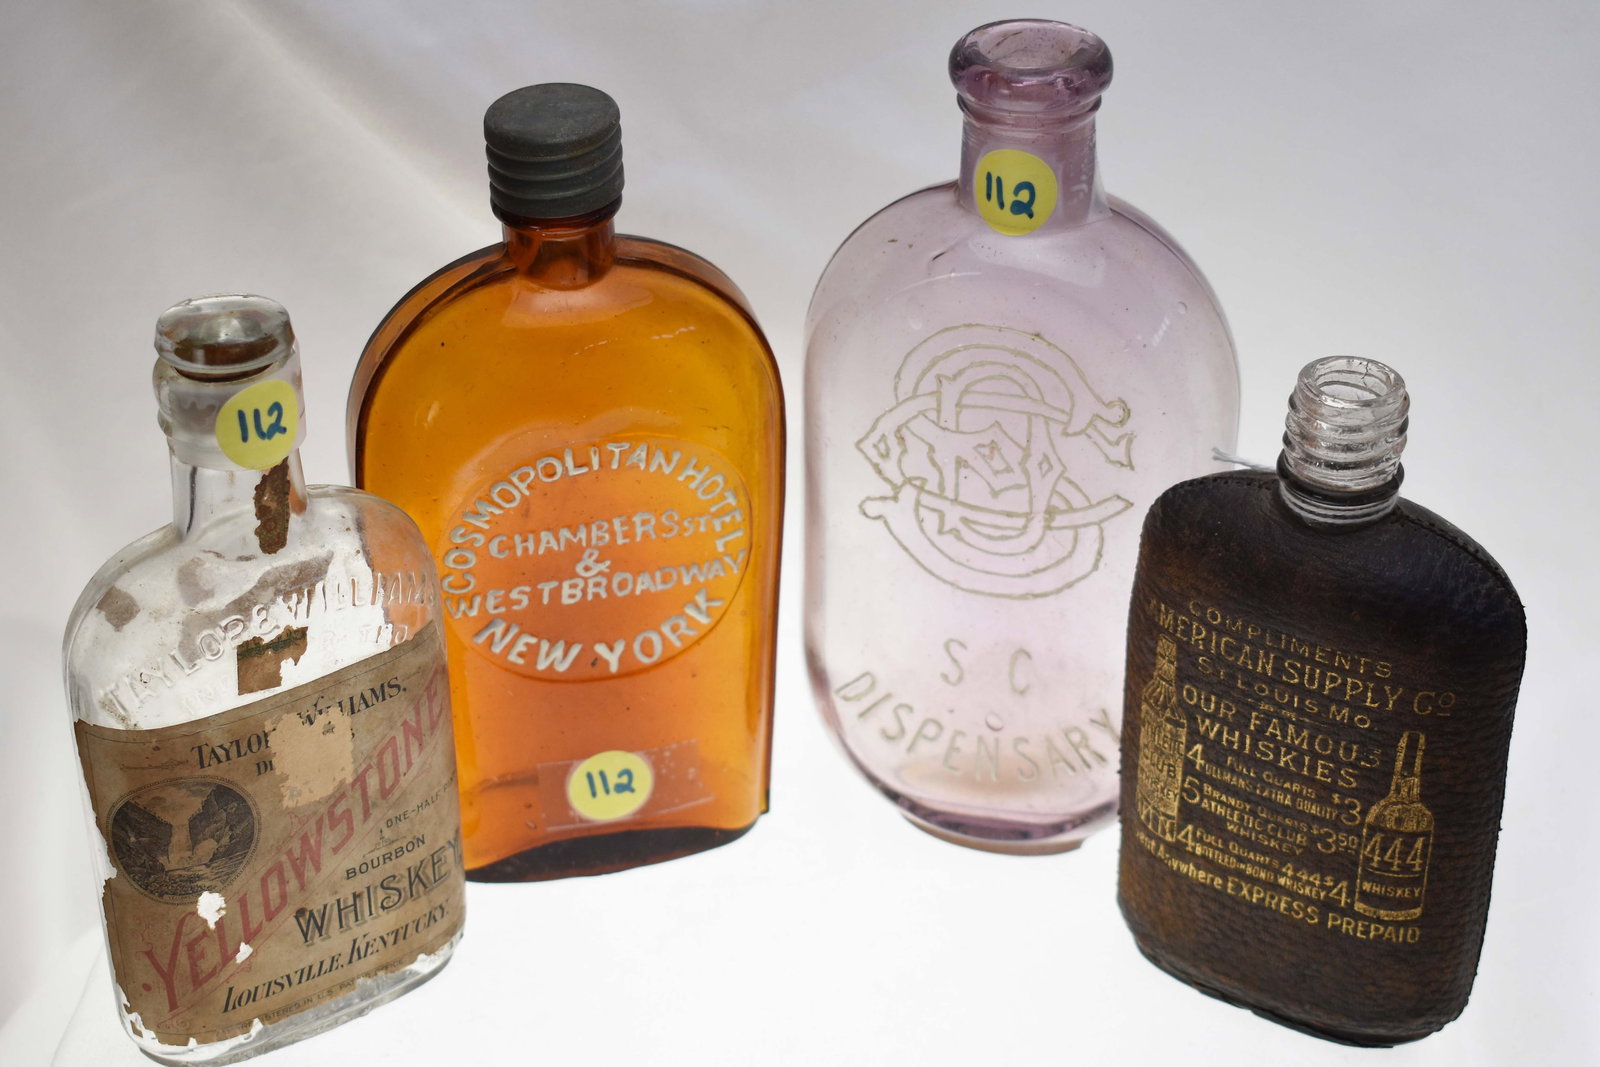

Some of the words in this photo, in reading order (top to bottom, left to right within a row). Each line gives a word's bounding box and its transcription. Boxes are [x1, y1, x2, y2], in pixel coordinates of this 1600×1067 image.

[985, 171, 1036, 220] 112
[237, 401, 287, 443] 112
[441, 442, 681, 595] COSMOPOLITAN
[677, 456, 745, 553] HOTEL
[488, 508, 679, 558] CHAMBERS
[575, 549, 611, 577] &
[472, 618, 582, 672] NEW
[594, 588, 724, 674] YORK
[1189, 600, 1393, 678] COMPLIMENTS
[940, 638, 968, 687] S
[1008, 648, 1032, 696] C
[1282, 658, 1403, 711] SUPPLY
[834, 671, 1121, 782] DISPENSARY
[1182, 684, 1237, 721] OUR
[1250, 711, 1382, 767] FAMOUS
[1196, 714, 1359, 788] WHISKIES
[586, 768, 636, 799] 112
[1203, 783, 1251, 812] BRANDY
[1226, 755, 1256, 777] FULL
[1262, 771, 1316, 799] QUARTS
[1201, 799, 1264, 831] ATHLETIC
[1267, 823, 1308, 847] CLUB
[1296, 798, 1339, 821] QUALITY
[346, 834, 426, 880] BOURBON
[1196, 828, 1224, 849] FULL
[1228, 841, 1279, 869] QUARTS
[1226, 821, 1303, 855] WHISKEY
[1364, 832, 1427, 872] 444
[293, 828, 461, 944] WHISKEY
[1227, 876, 1319, 924] EXPRESS
[1327, 912, 1420, 944] PREPAID
[1277, 873, 1327, 900] WHISKEY
[1361, 881, 1423, 898] WHISKEY
